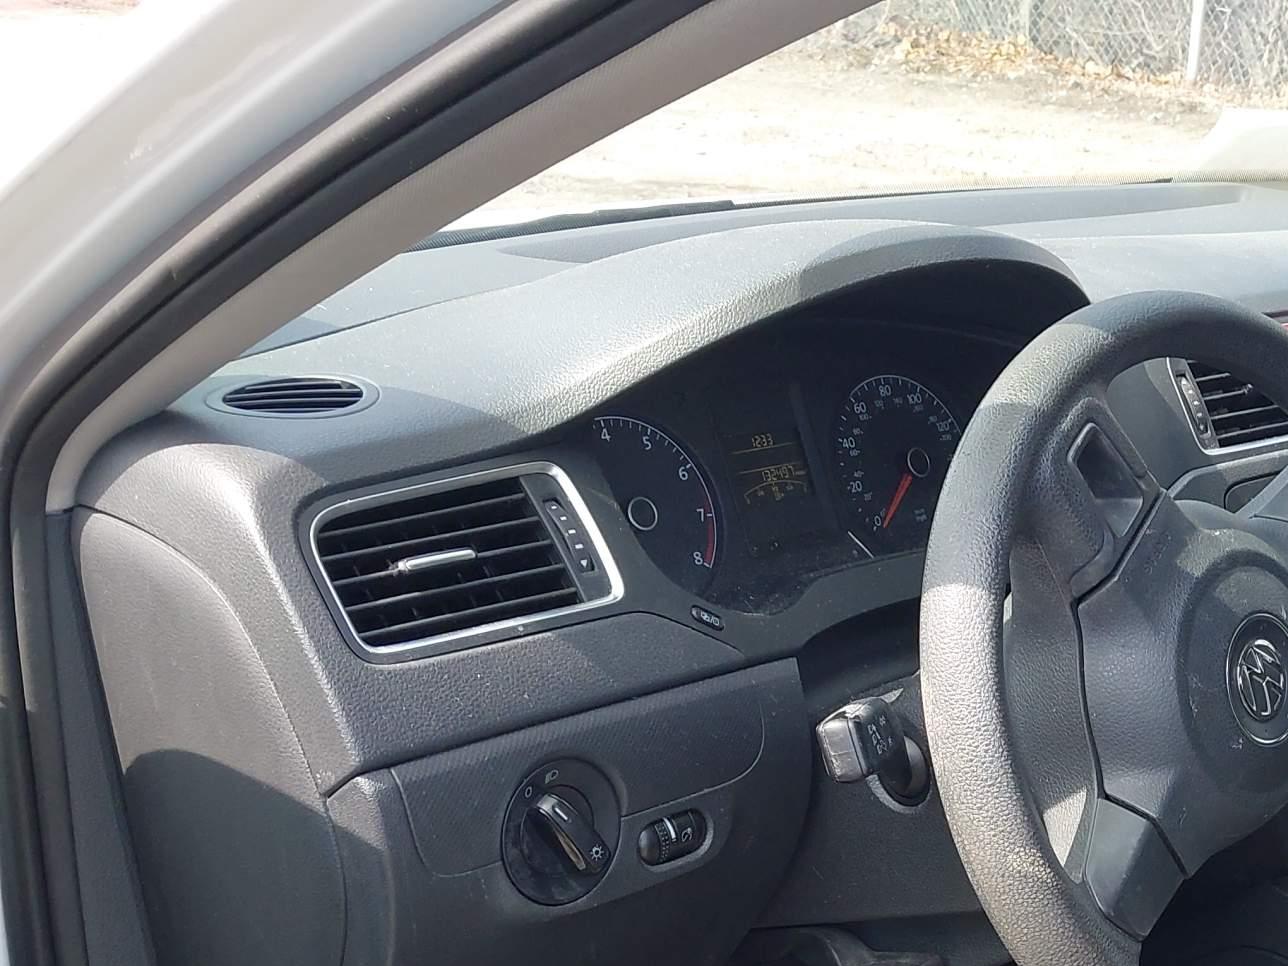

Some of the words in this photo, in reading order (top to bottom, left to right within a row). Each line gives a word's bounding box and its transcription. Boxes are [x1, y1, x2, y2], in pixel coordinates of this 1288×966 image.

[878, 384, 892, 397] 80
[906, 393, 922, 405] 100
[853, 402, 867, 414] 60
[601, 428, 611, 442] 4
[642, 436, 652, 450] 5
[842, 436, 856, 449] 40
[678, 466, 689, 481] 6
[849, 481, 863, 493] 20
[696, 508, 705, 522] 7
[693, 551, 703, 566] 8
